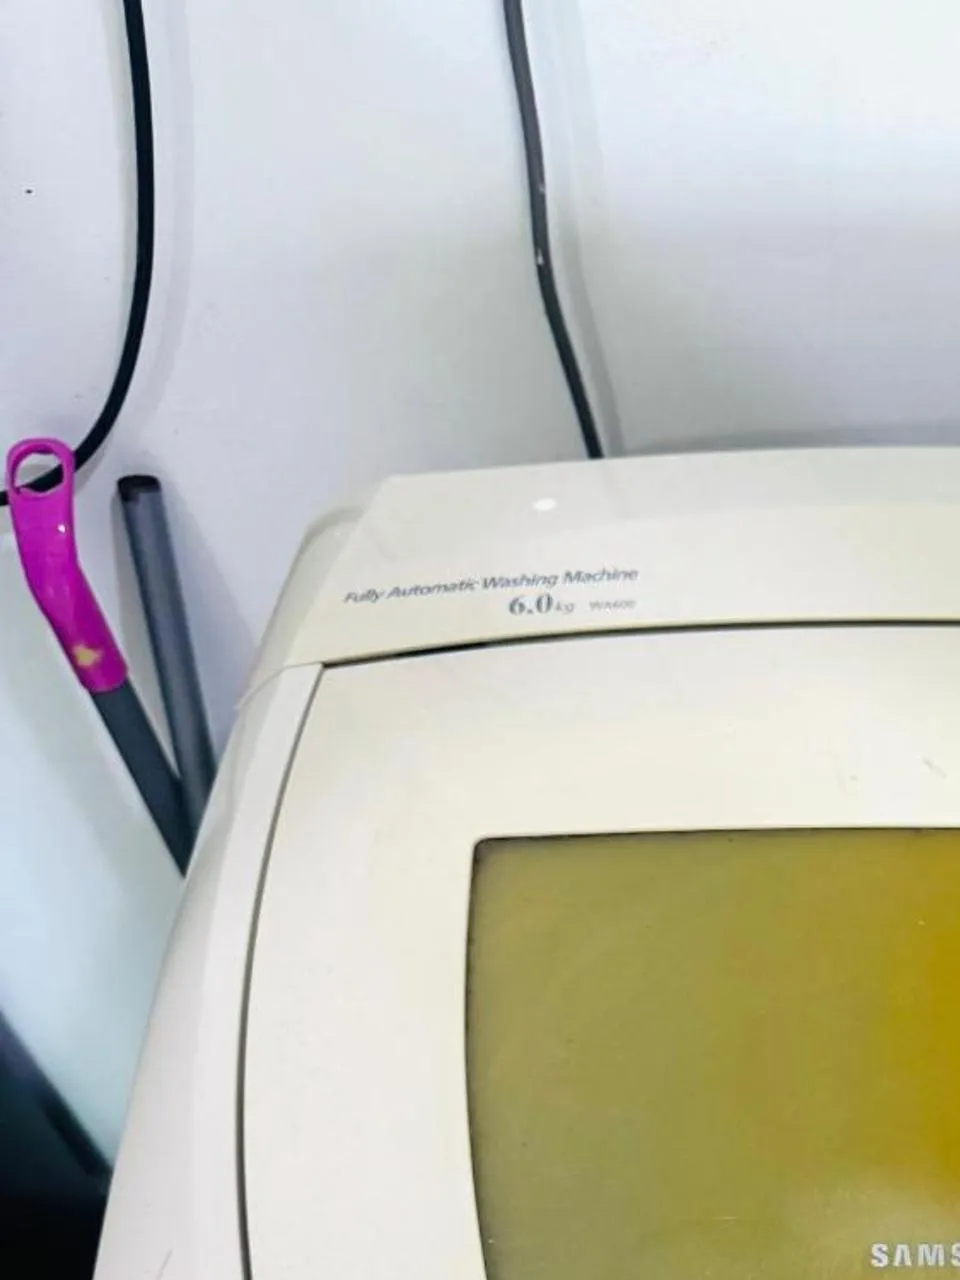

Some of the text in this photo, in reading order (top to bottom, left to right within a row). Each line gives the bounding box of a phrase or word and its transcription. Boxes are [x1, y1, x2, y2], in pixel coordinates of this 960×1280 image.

[343, 567, 639, 604] Fully Automatic Washing Machine
[508, 593, 554, 616] 6.0
